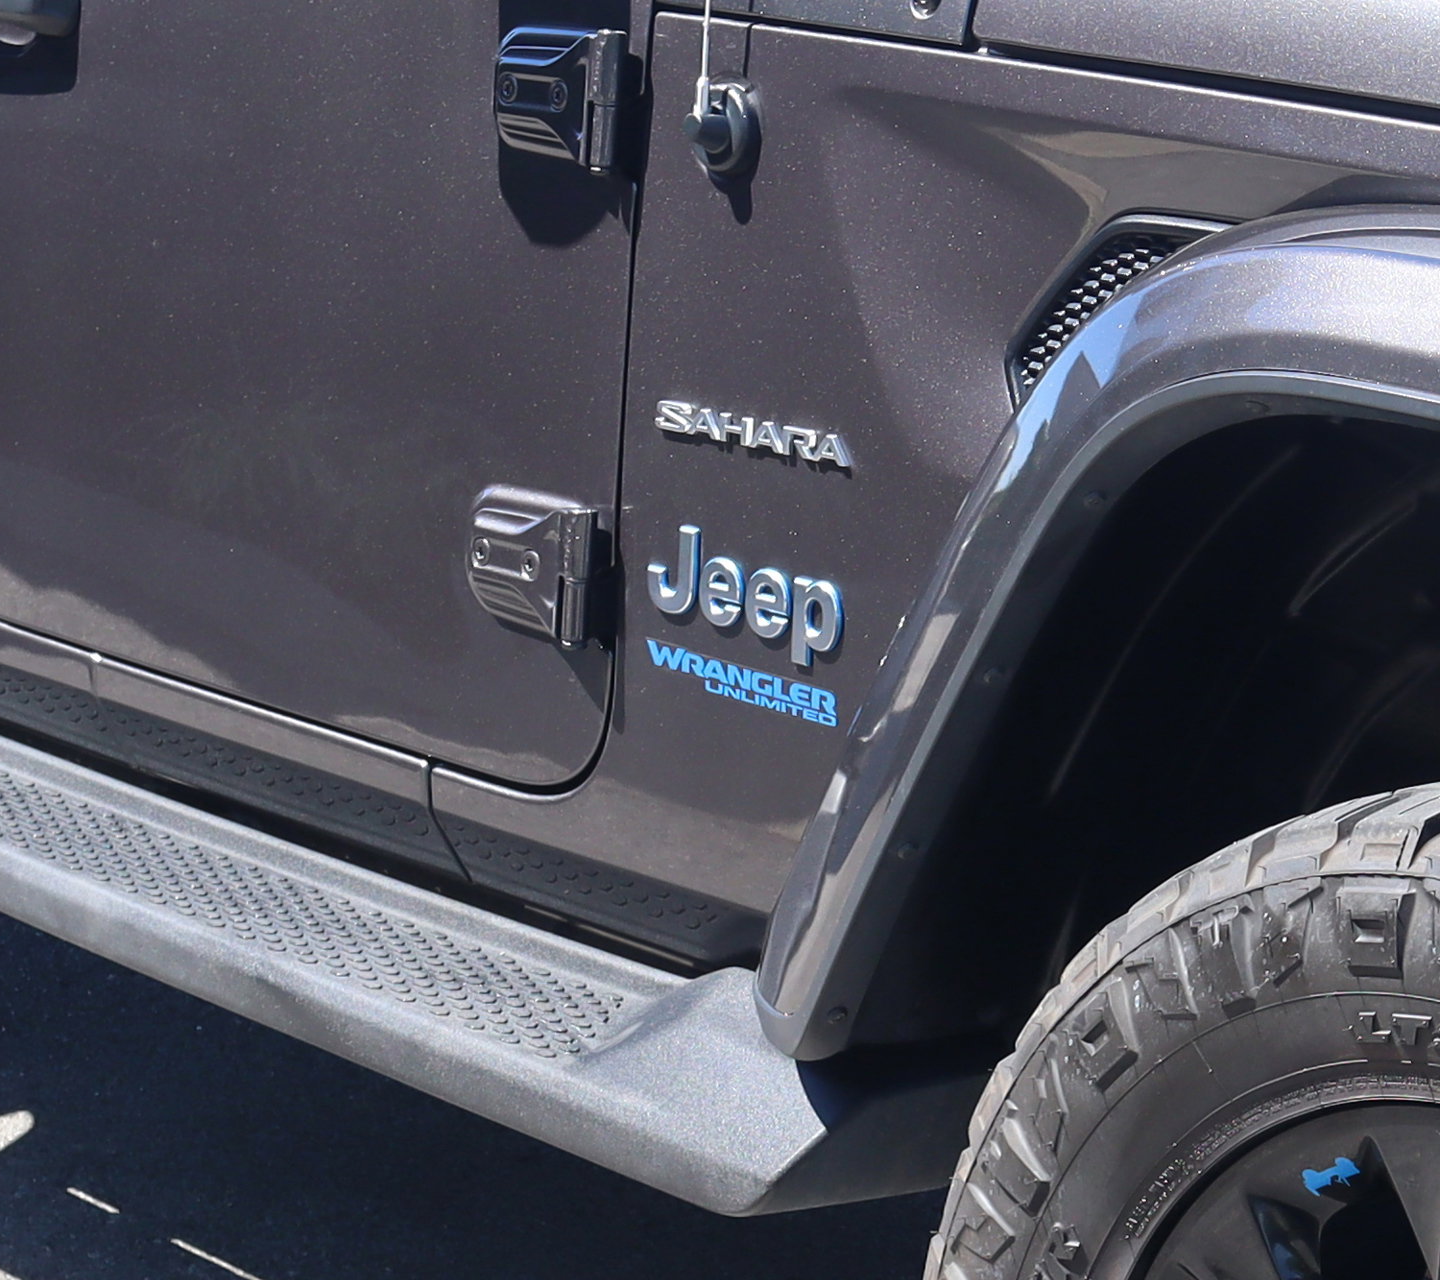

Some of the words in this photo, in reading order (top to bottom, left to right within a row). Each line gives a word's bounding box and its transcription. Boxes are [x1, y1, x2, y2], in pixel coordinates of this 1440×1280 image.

[654, 400, 853, 467] SAHARA
[647, 525, 845, 667] Jeep
[646, 638, 837, 716] WRANGLER
[705, 679, 839, 728] UNLIMITED
